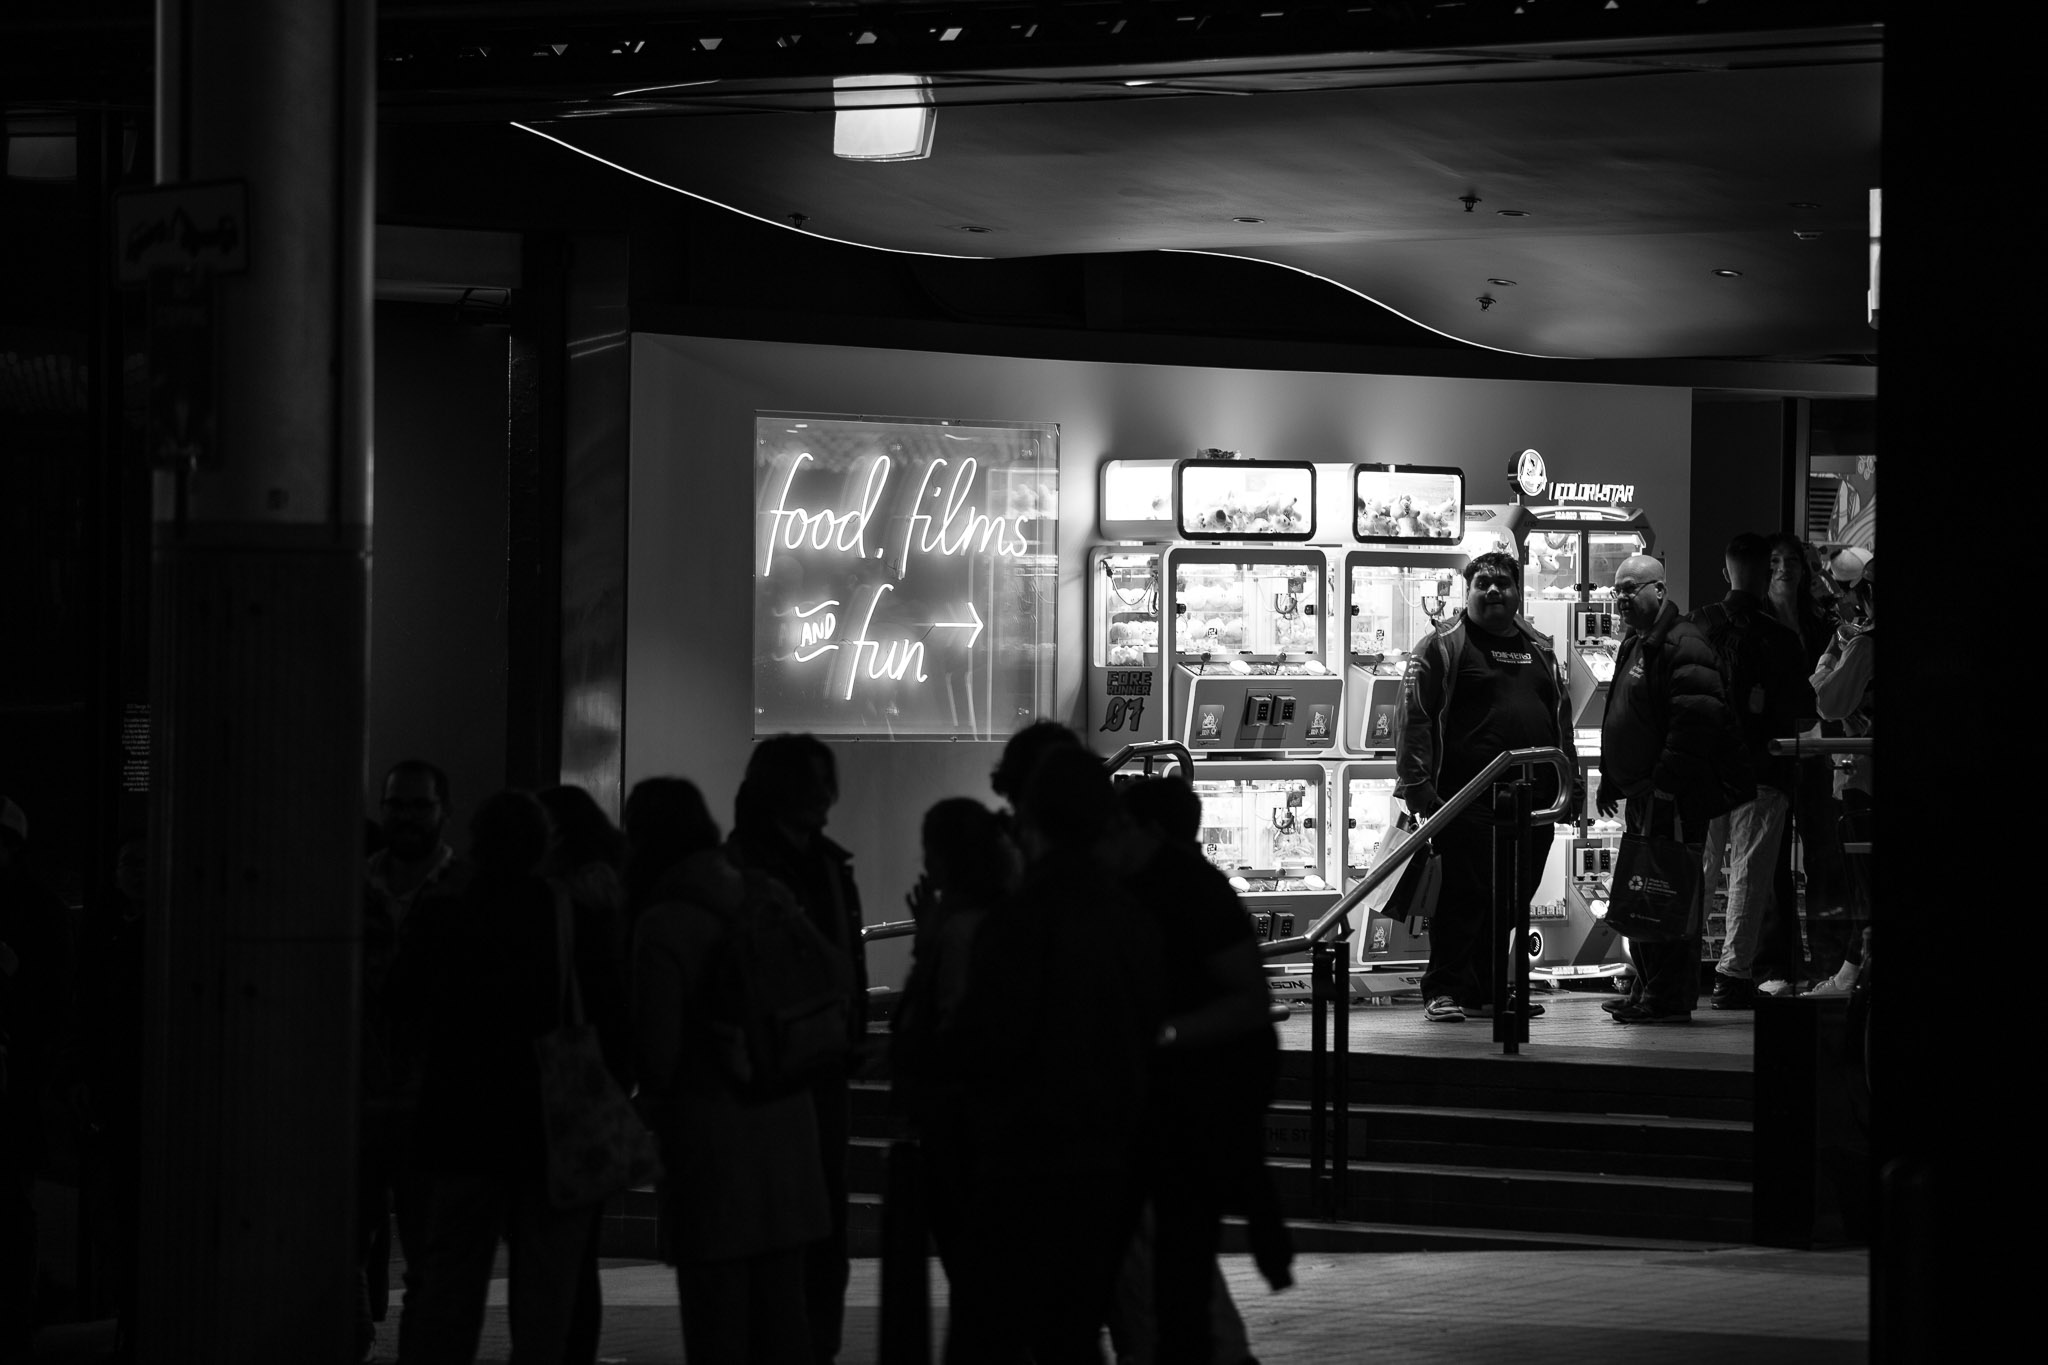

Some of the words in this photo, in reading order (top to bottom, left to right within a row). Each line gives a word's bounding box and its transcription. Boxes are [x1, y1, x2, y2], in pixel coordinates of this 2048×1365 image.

[898, 456, 1029, 580] films
[800, 612, 836, 647] AND
[845, 583, 928, 701] fun
[1106, 671, 1153, 686] FORE
[1106, 685, 1151, 696] RUNNER
